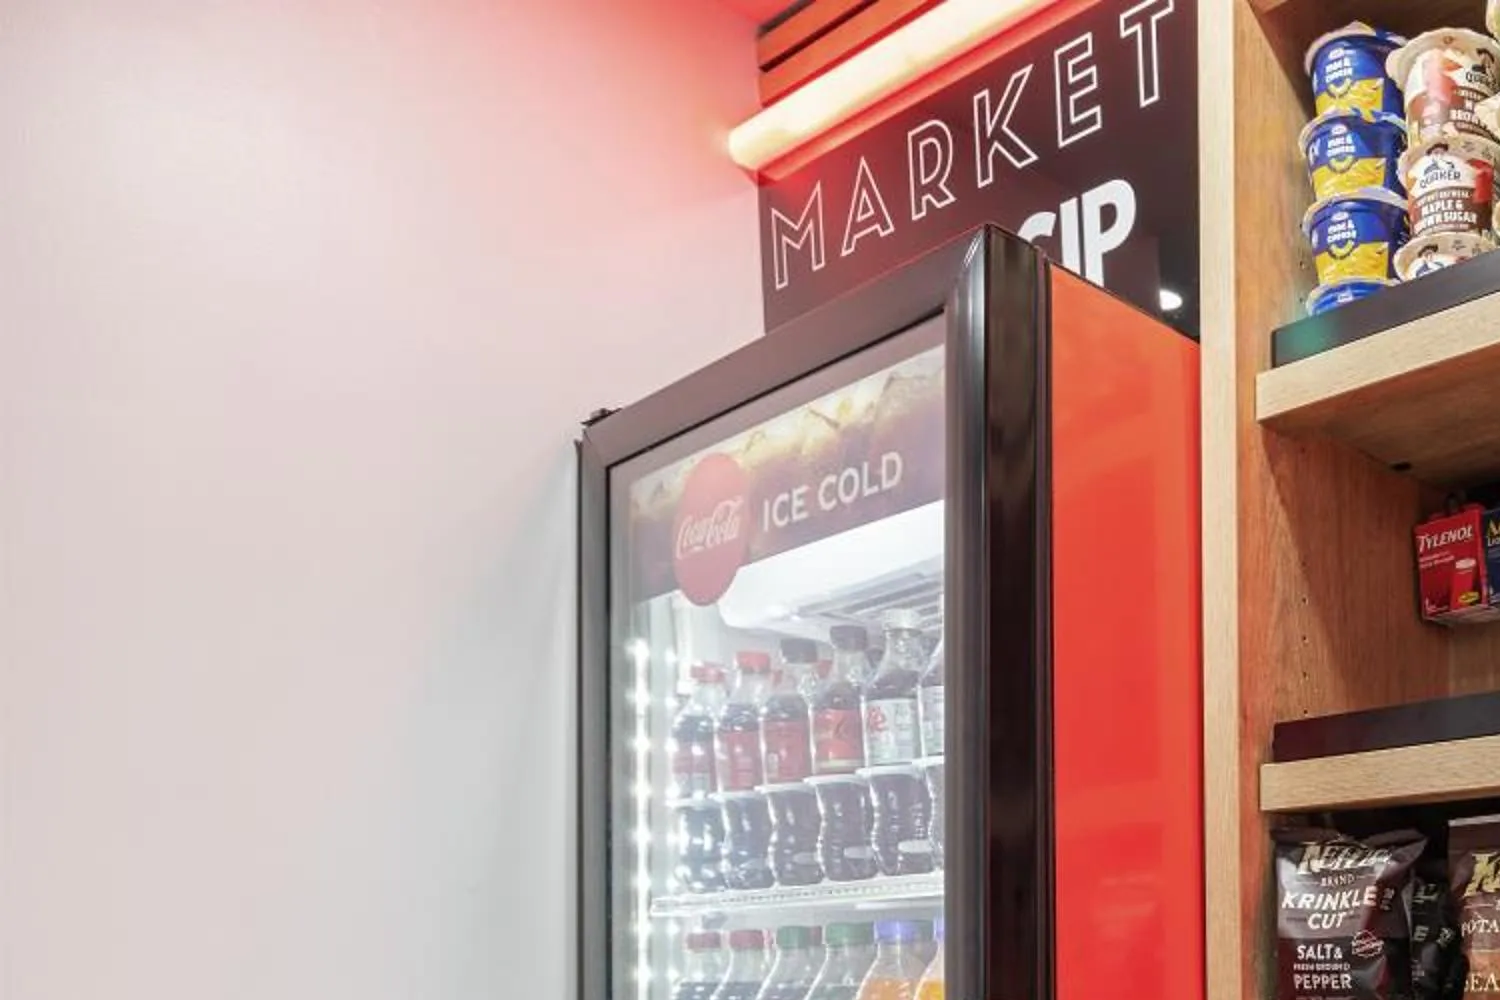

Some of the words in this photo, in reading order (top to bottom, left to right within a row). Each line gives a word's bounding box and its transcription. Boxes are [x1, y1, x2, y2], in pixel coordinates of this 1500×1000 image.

[770, 0, 1176, 291] MARKET
[1420, 170, 1462, 190] QUAKER
[763, 484, 811, 532] ICE
[818, 451, 903, 511] COLD
[1416, 525, 1474, 553] TYLENOL
[1281, 885, 1378, 911] KRINKLE
[1307, 910, 1347, 929] CUT
[1293, 973, 1353, 990] PEPPER
